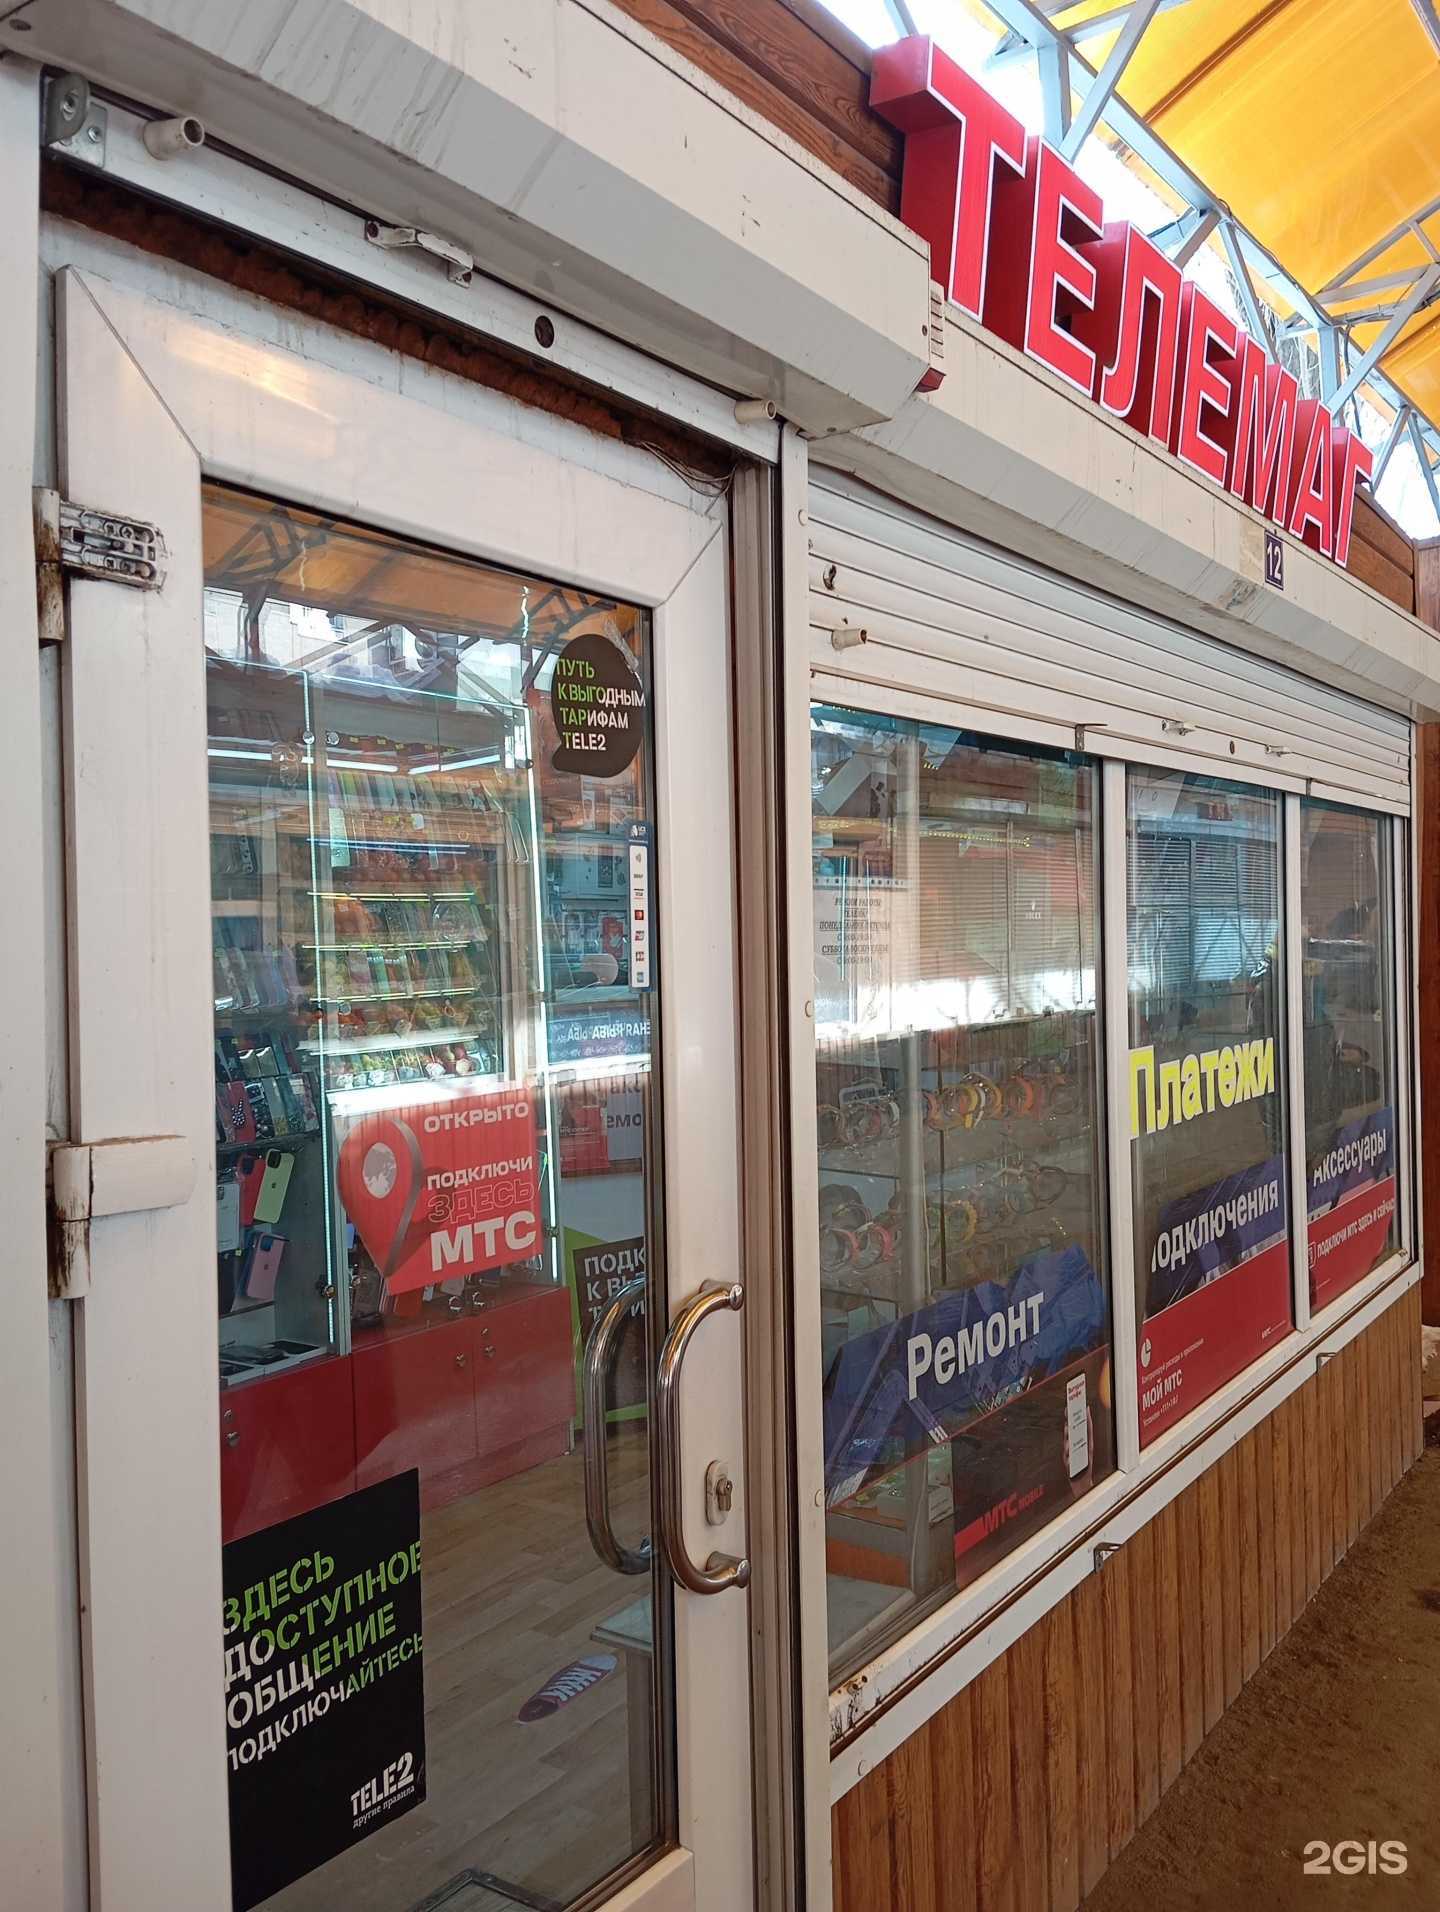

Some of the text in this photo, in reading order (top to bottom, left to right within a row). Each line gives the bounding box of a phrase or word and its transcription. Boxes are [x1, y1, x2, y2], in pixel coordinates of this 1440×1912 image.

[928, 39, 1374, 568] ТЕЛЕМАГ
[1267, 541, 1282, 580] 12
[556, 658, 595, 678] ПУТЬ
[558, 682, 646, 707] К ВЫГОДНЫМ
[560, 707, 629, 729] ТАРИФАМ
[562, 732, 606, 750] TELE2
[1129, 1037, 1275, 1140] Платежи
[424, 1102, 529, 1133] ОТКРЫТО
[427, 1156, 533, 1191] ПОДКЛЮЧИ
[428, 1179, 535, 1224] ЗДЕСЬ
[430, 1210, 536, 1272] МТС
[906, 1291, 1044, 1401] Ремонт
[1142, 1378, 1163, 1411] МОЙ
[1165, 1369, 1183, 1396] МТС
[223, 1551, 335, 1636] ЗДЕСЬ
[227, 1602, 396, 1729] ОБЩЕНИЕ
[351, 1752, 414, 1816] TELE2
